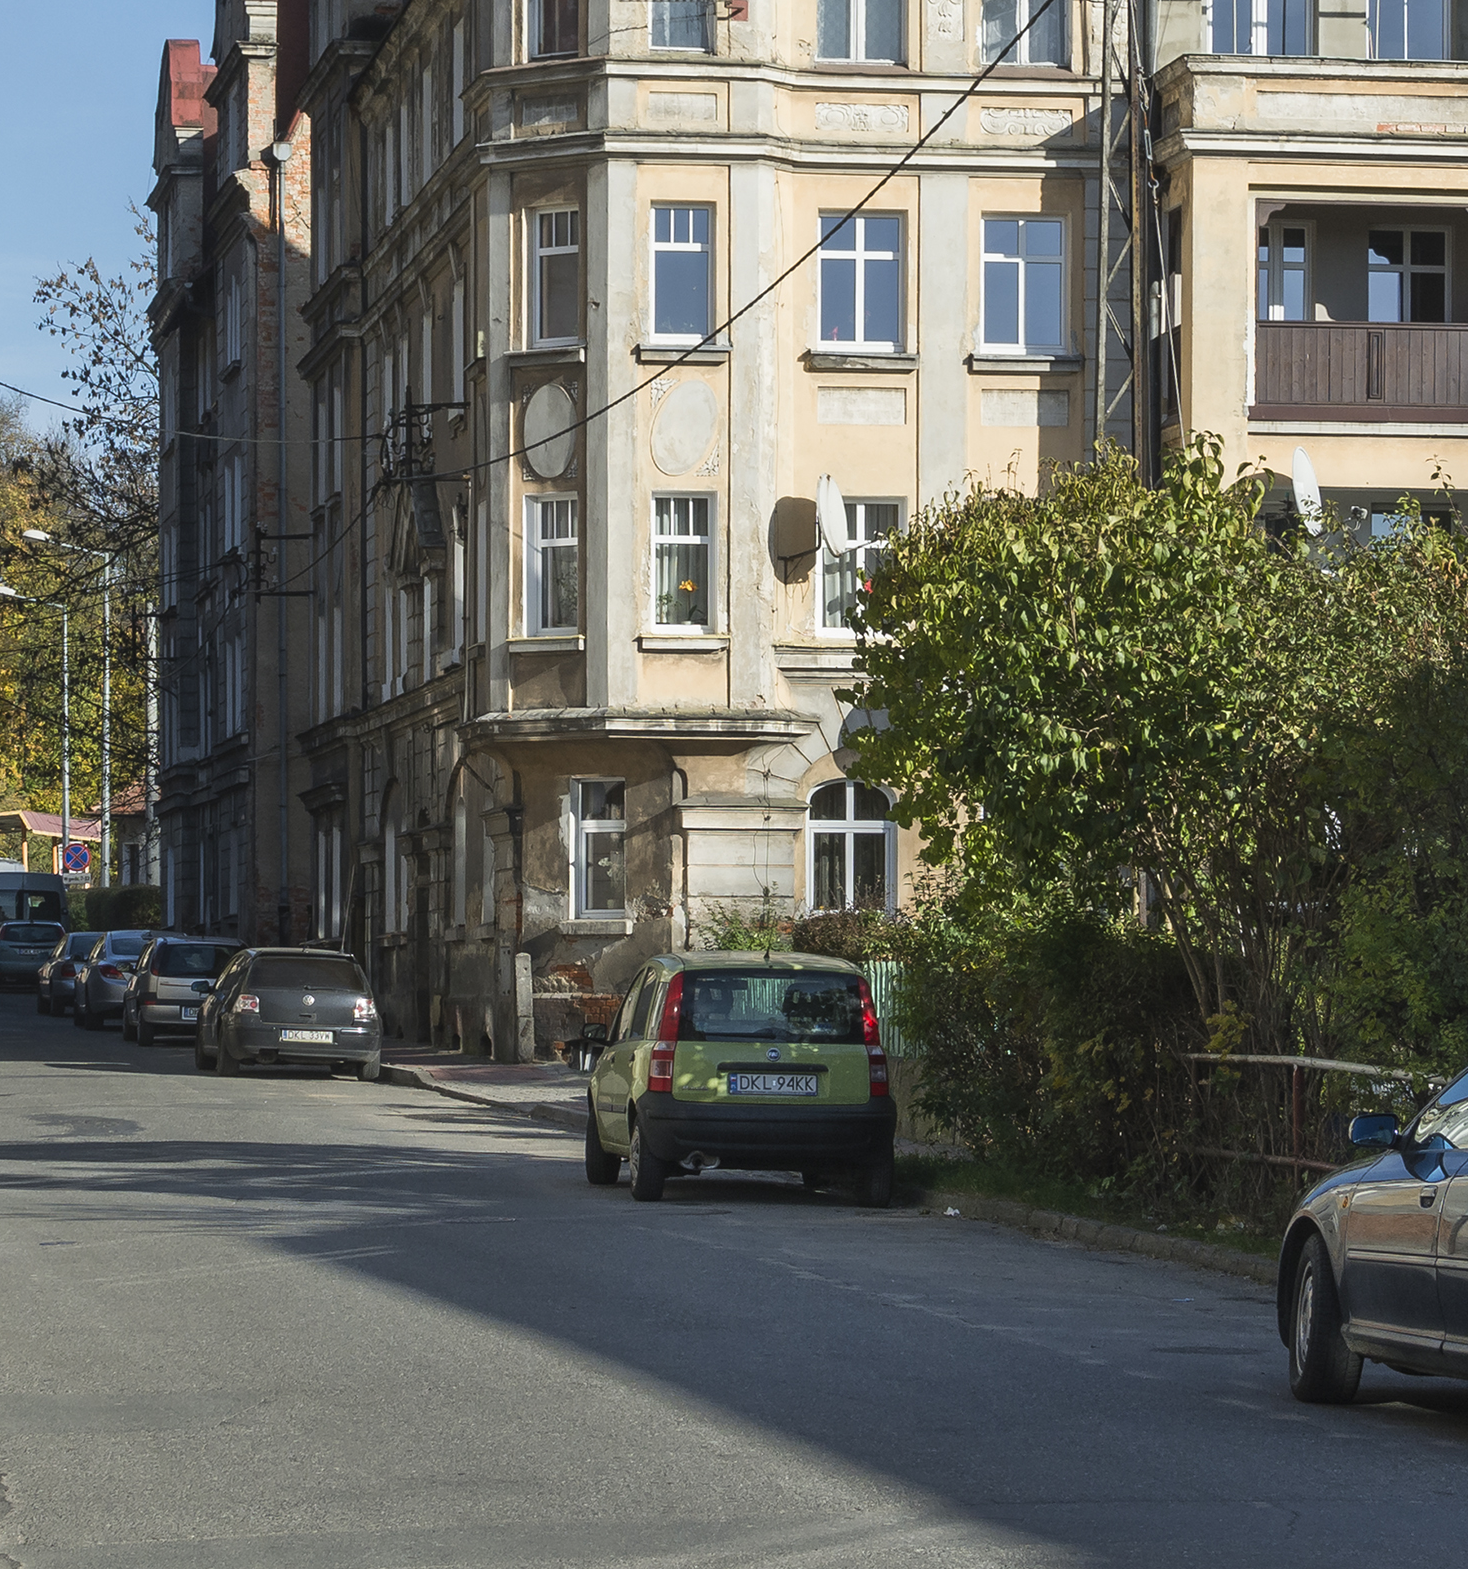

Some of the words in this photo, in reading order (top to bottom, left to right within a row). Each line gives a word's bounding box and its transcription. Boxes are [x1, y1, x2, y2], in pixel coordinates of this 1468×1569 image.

[287, 1030, 306, 1040] DKL
[739, 1075, 772, 1091] DKL
[777, 1076, 815, 1092] 94KK
